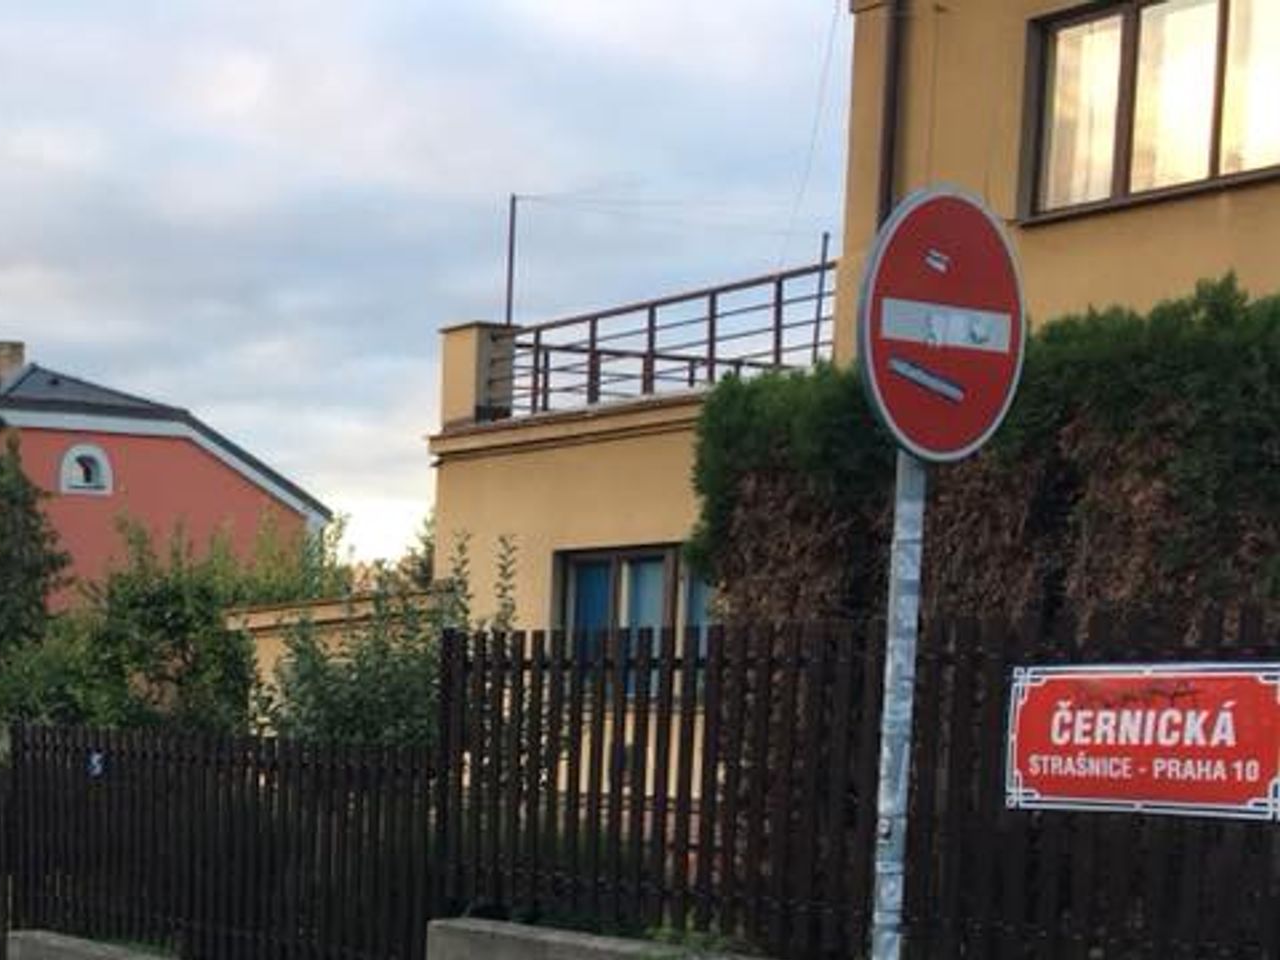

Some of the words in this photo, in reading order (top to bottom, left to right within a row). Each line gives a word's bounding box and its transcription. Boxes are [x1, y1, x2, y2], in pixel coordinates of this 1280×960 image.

[1050, 701, 1237, 747] ČERNICKÁ
[1028, 753, 1133, 779] STRAŠNICE
[1152, 758, 1227, 781] PRAHA
[1232, 759, 1260, 782] 10
